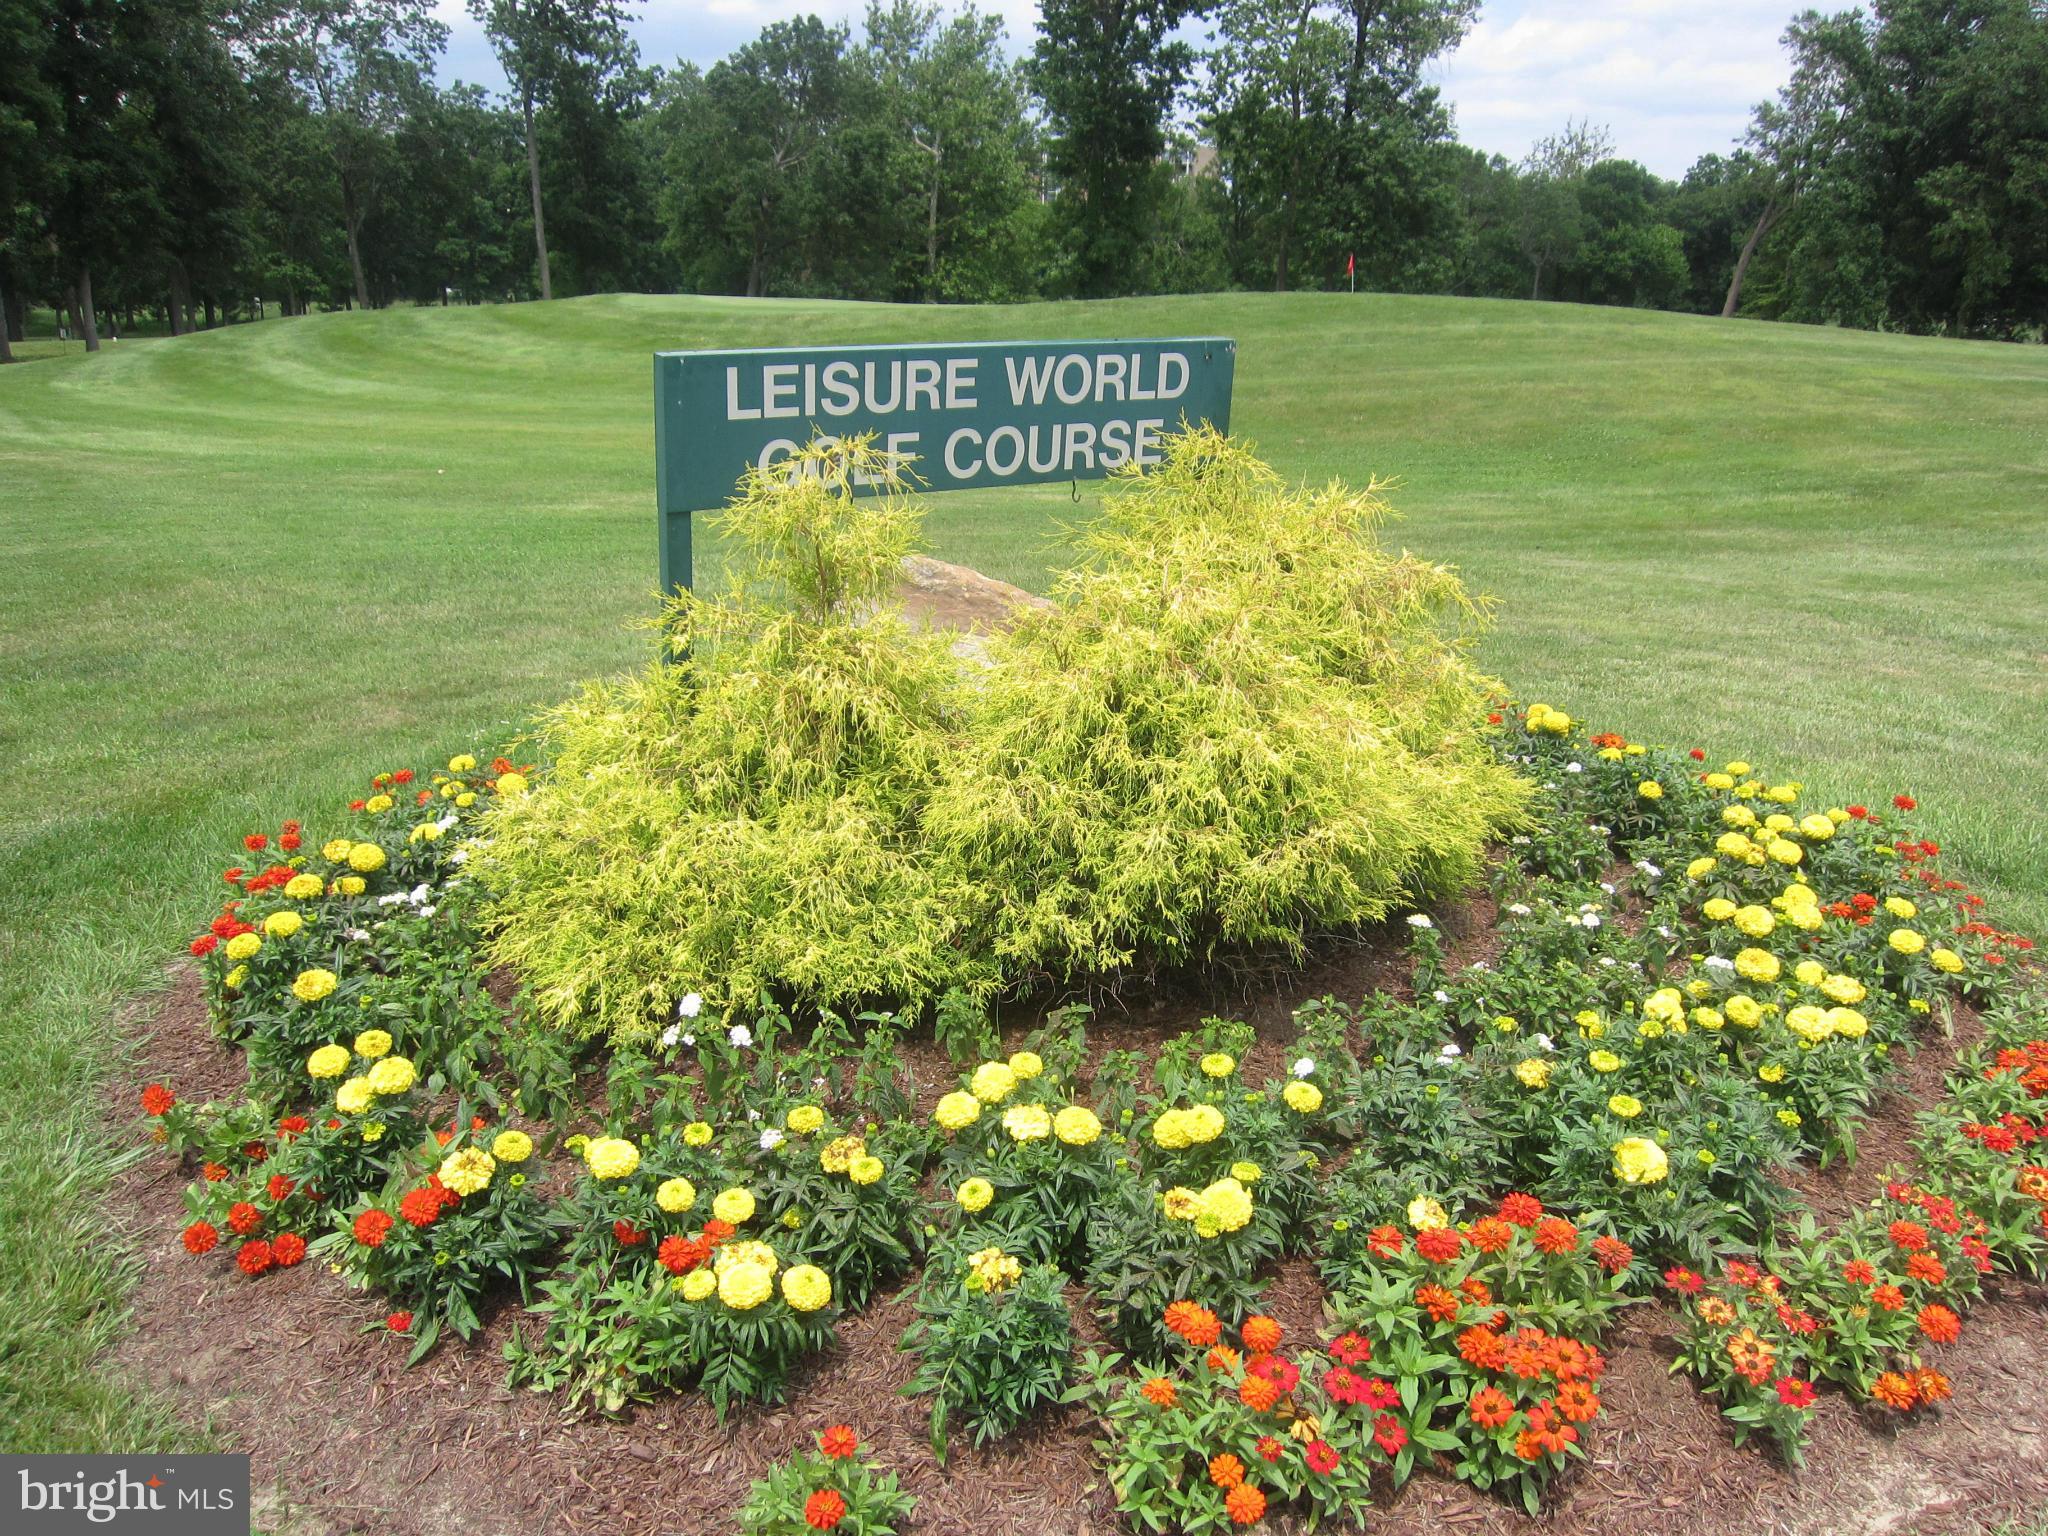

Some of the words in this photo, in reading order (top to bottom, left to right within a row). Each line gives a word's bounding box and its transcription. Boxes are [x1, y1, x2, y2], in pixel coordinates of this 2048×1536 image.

[726, 358, 979, 421] LEISURE
[1005, 352, 1190, 406] WORLD
[944, 418, 1164, 480] COURSE
